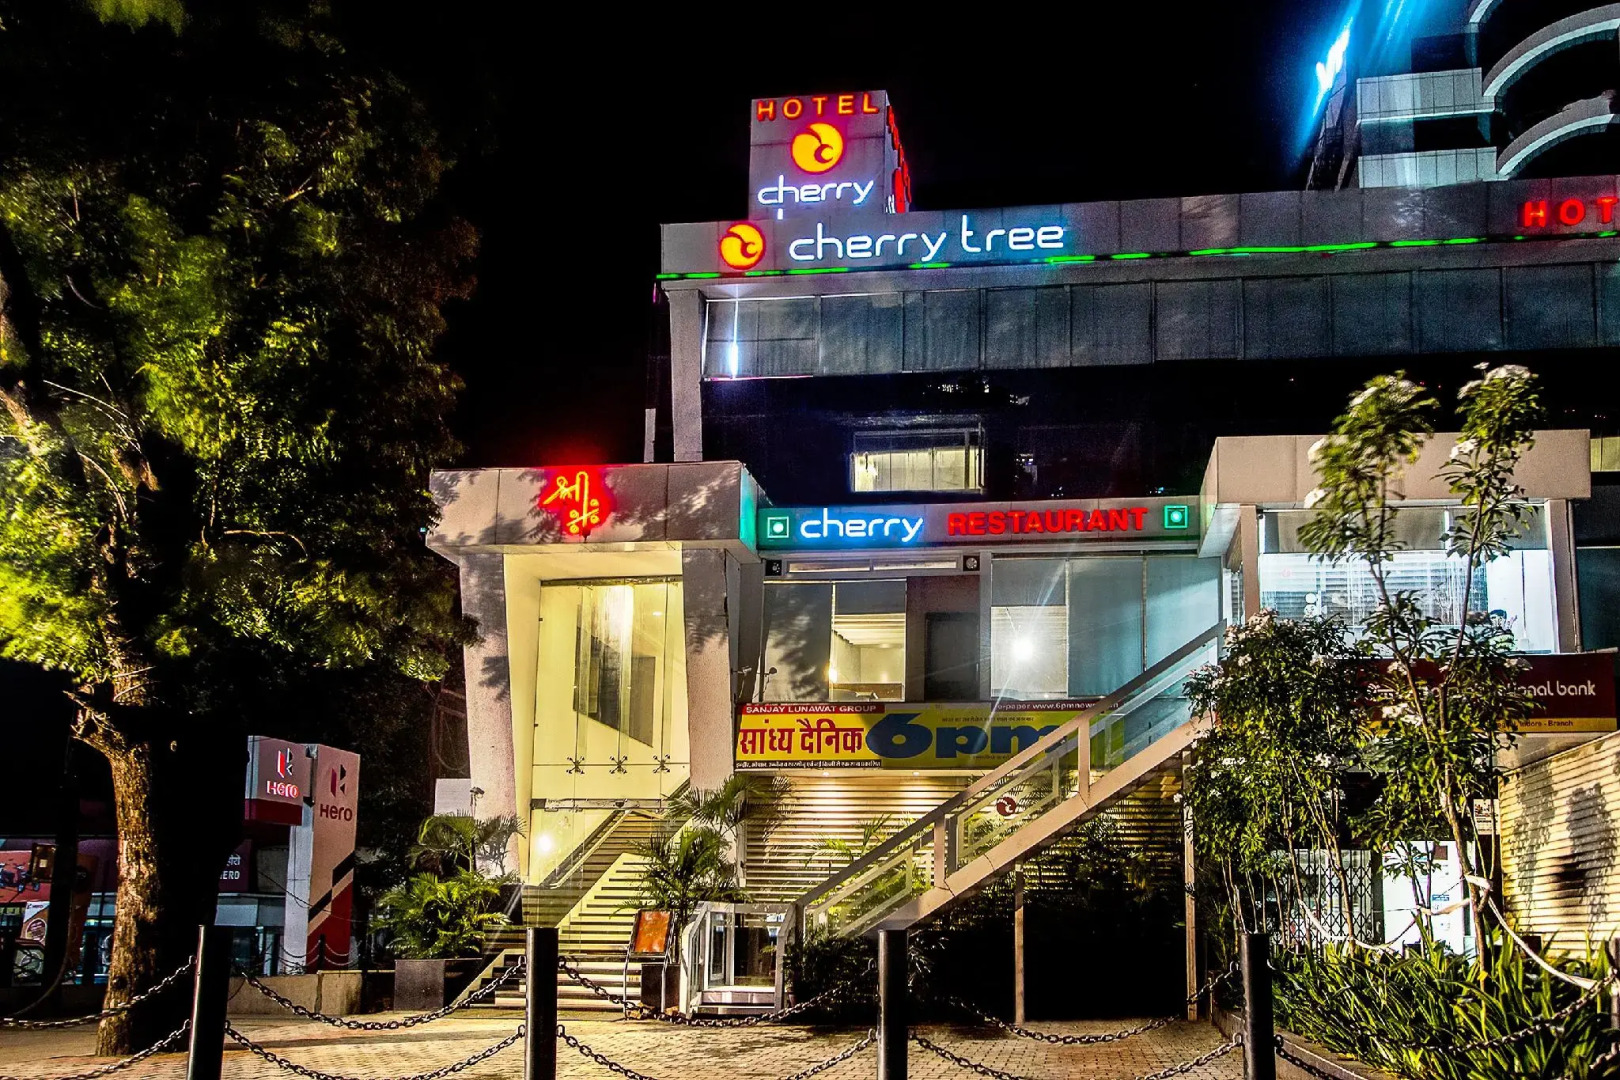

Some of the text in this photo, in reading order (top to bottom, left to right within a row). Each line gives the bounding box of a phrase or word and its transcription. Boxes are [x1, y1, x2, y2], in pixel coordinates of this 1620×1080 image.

[756, 93, 879, 121] HOTEL
[757, 174, 874, 205] cherry
[789, 215, 1065, 262] cherry tree
[800, 507, 1148, 543] cherry RESTAURANT
[1557, 680, 1597, 697] bank
[746, 705, 877, 714] SANJAY LUNAWAT GROUP
[1548, 719, 1574, 727] Branch
[739, 718, 865, 755] सांध्य दैनिक
[865, 713, 1068, 759] 6pm
[266, 780, 300, 798] Hero
[319, 803, 353, 822] Hero
